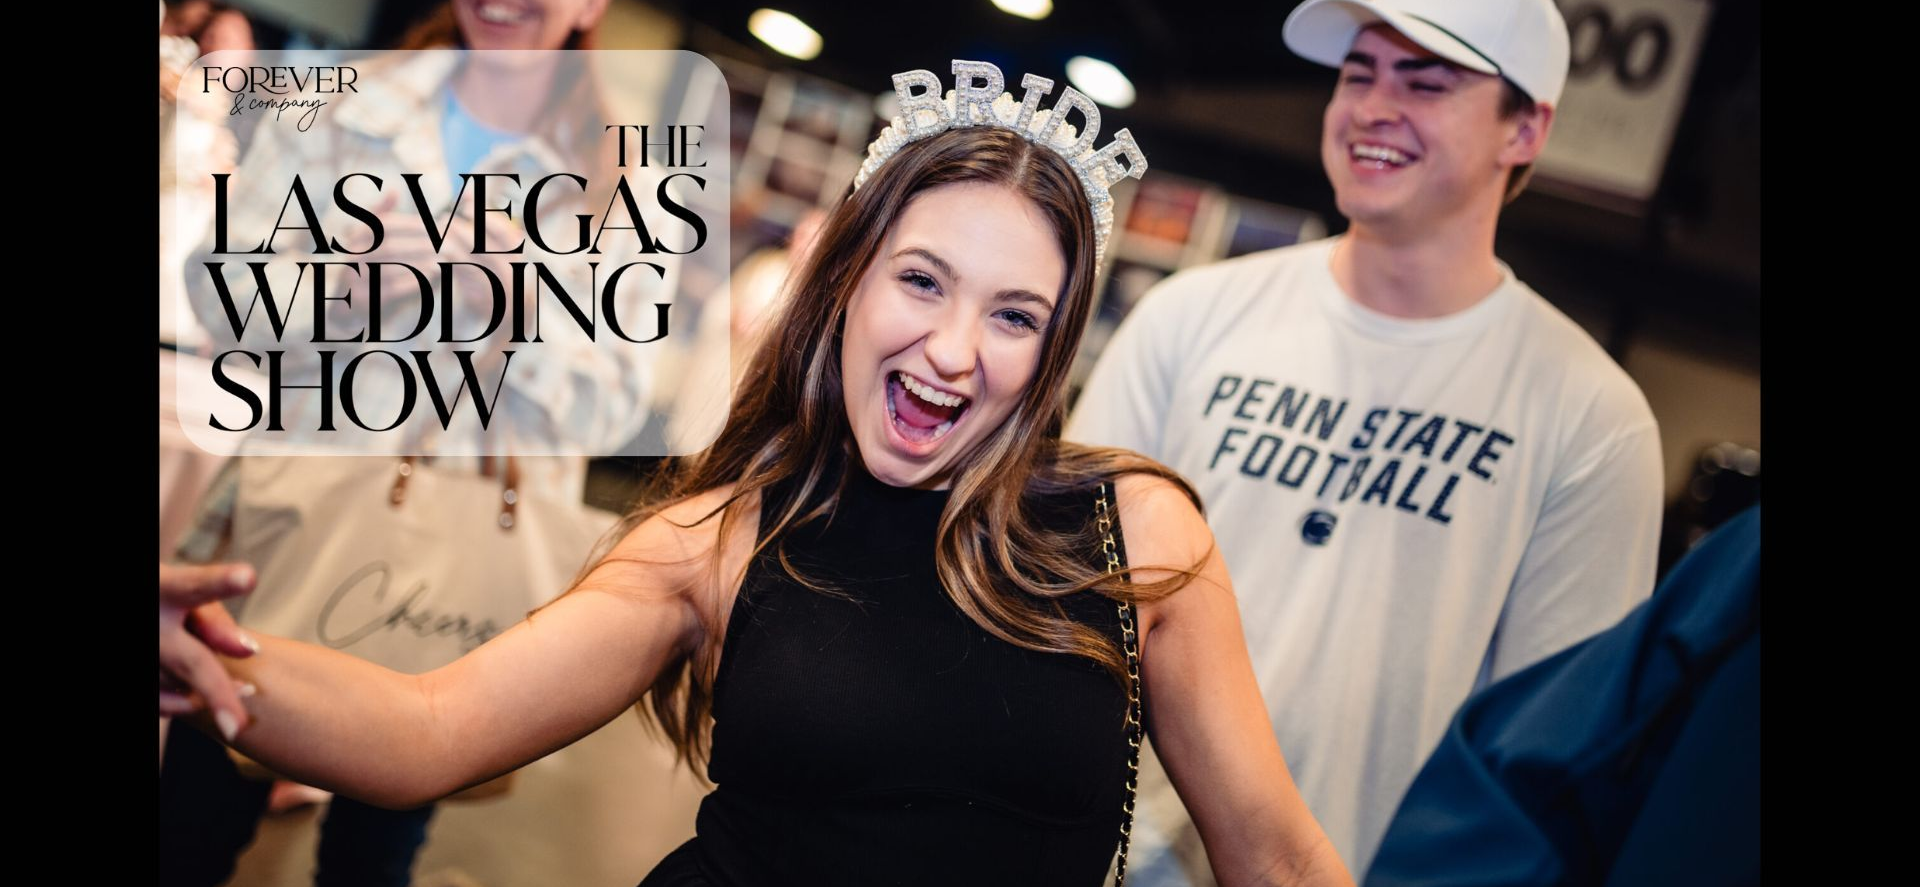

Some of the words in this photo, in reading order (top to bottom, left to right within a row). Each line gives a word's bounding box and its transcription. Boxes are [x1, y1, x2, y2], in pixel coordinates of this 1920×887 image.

[891, 58, 1149, 190] BRIDE
[1203, 375, 1348, 441] PENN
[1350, 405, 1514, 480] STATE
[1209, 428, 1461, 525] FOOTBALL
